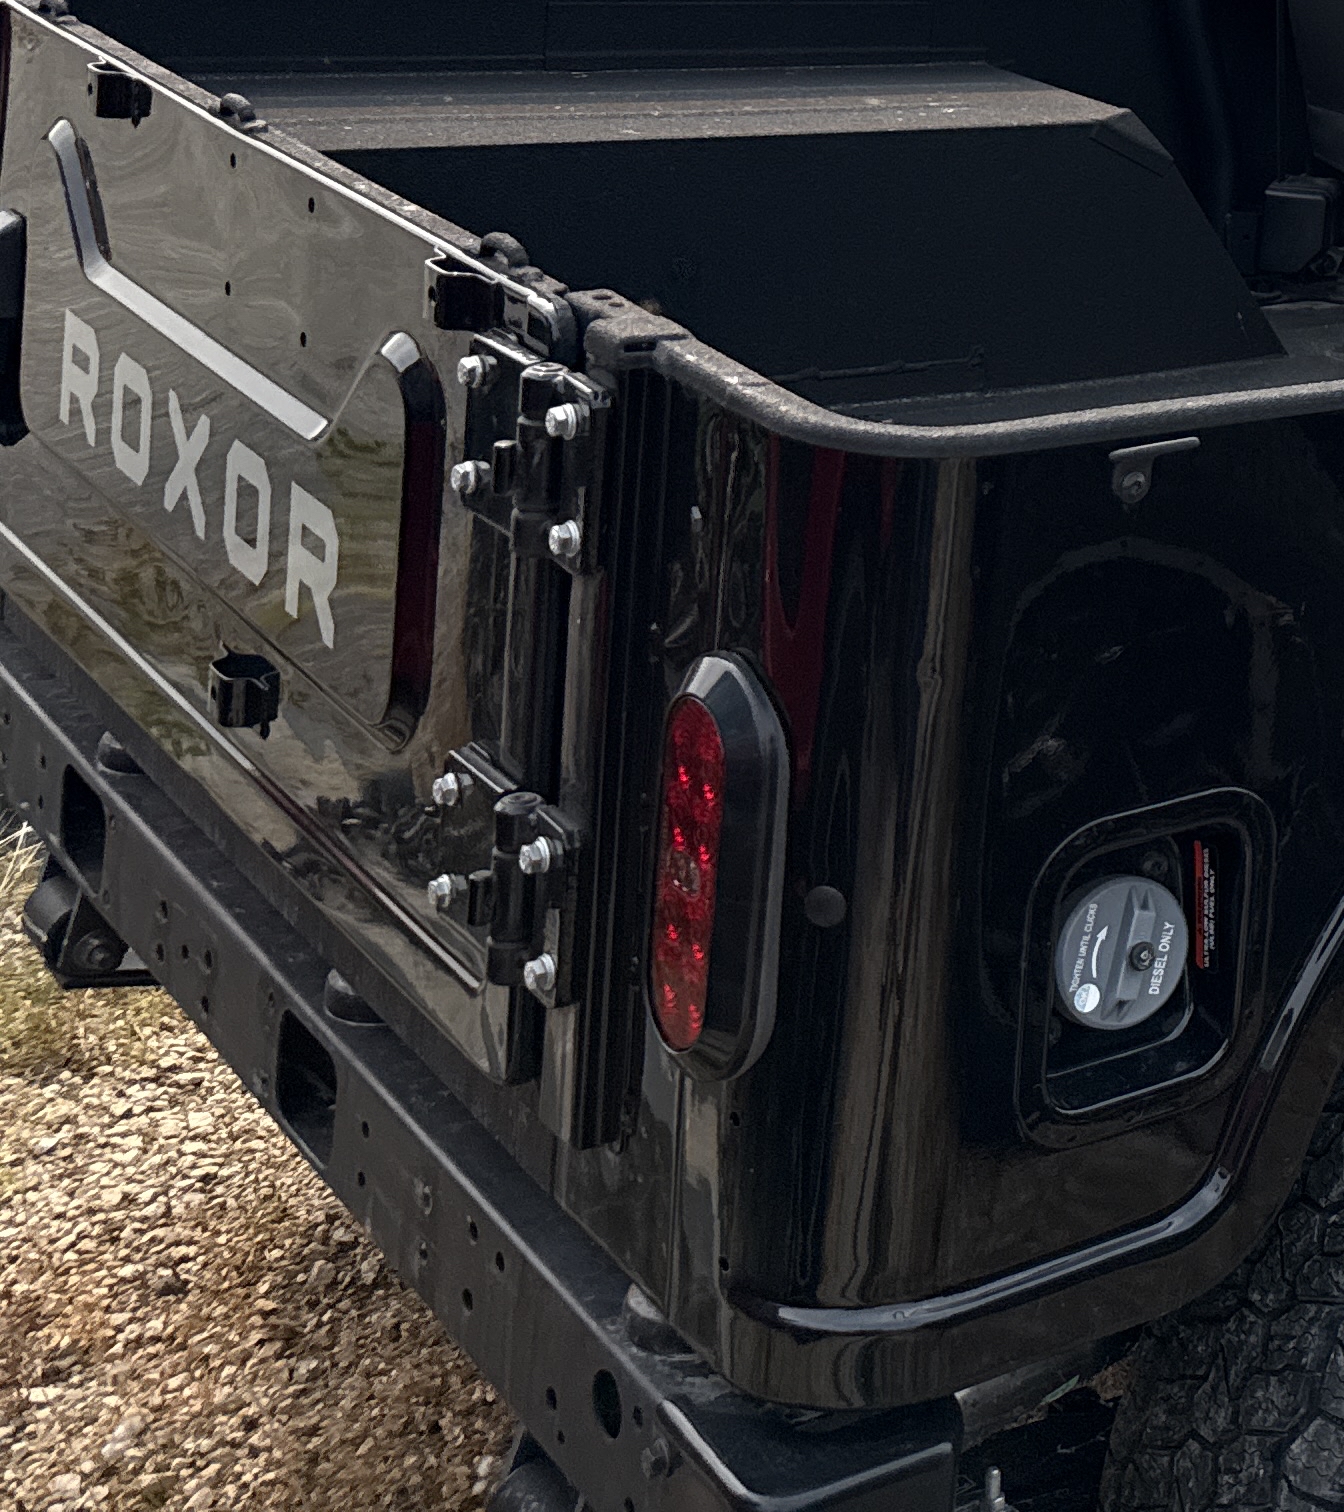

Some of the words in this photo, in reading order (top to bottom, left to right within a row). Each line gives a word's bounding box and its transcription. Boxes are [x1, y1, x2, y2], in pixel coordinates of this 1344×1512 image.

[59, 307, 340, 650] ROXOR
[1158, 921, 1176, 952] ONLY
[1069, 958, 1085, 992] TIGHTEN
[1077, 933, 1091, 957] UNTIL
[1148, 954, 1170, 995] DIESEL
